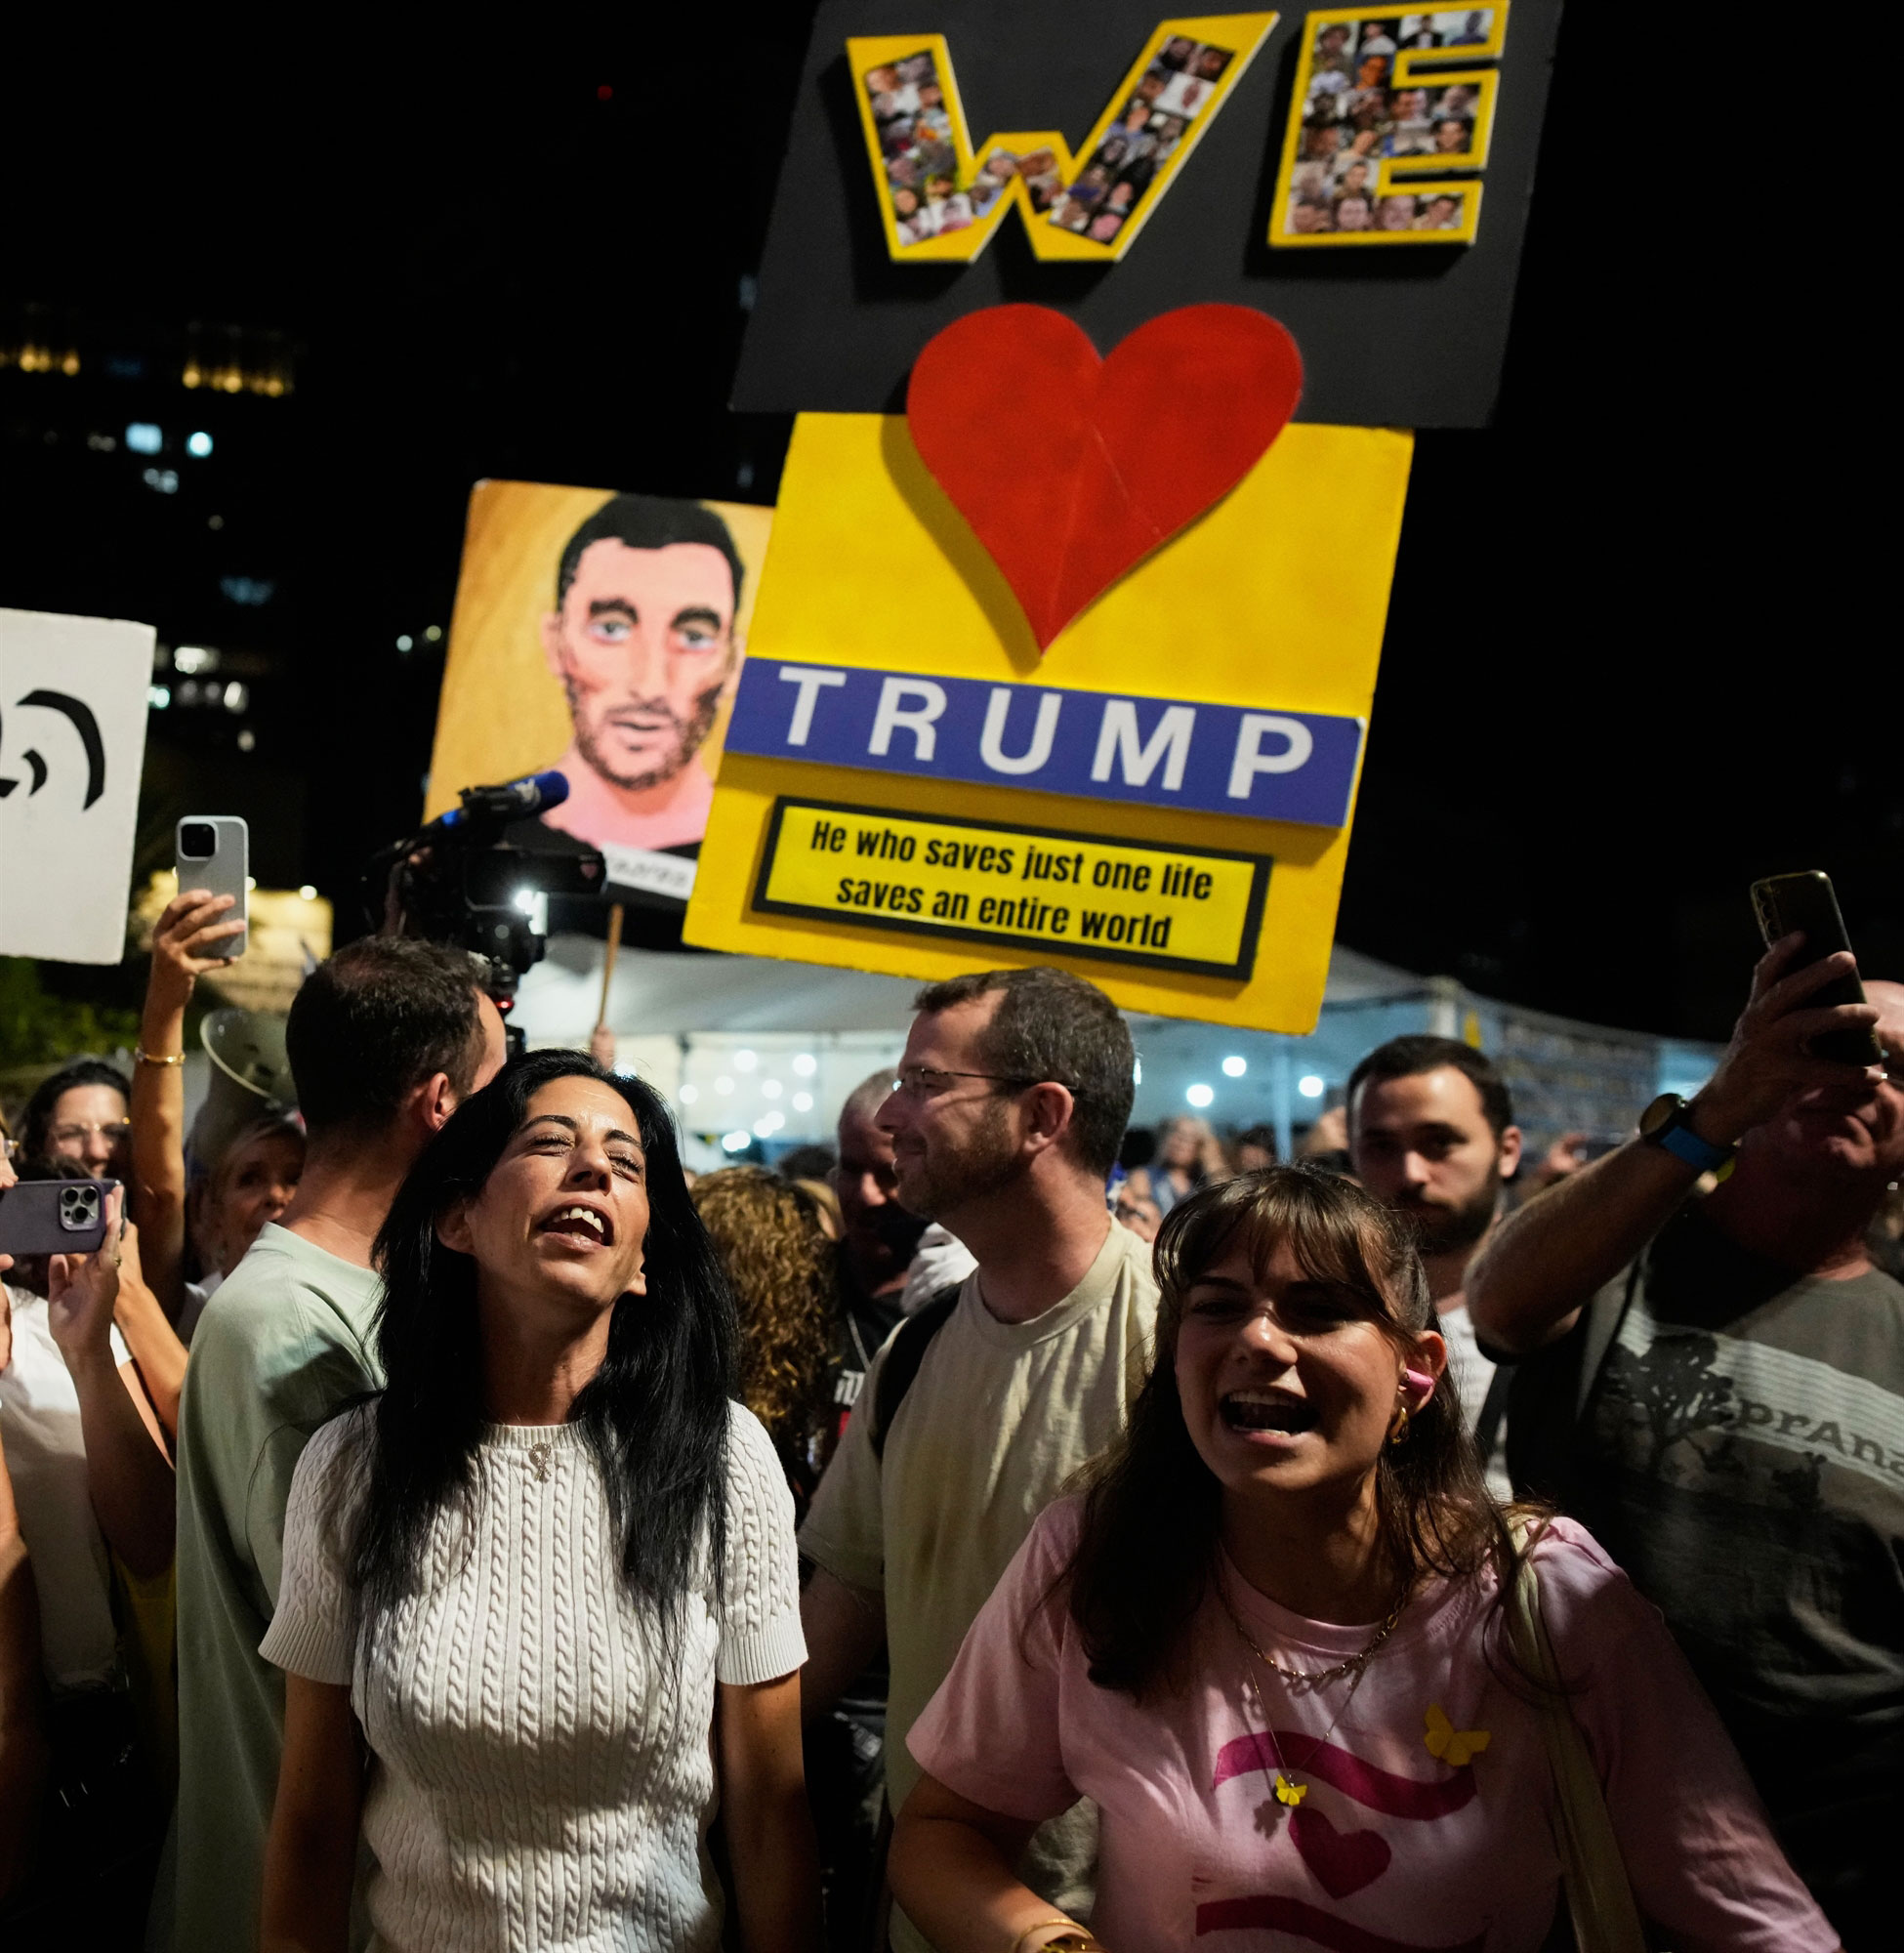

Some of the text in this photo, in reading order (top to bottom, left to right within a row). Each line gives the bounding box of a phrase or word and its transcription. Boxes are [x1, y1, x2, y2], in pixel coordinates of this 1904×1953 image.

[847, 0, 1511, 262] WE
[779, 667, 1313, 800] TRUMP
[810, 820, 1213, 900] He who saves just one life
[837, 878, 1173, 948] saves an entire world
